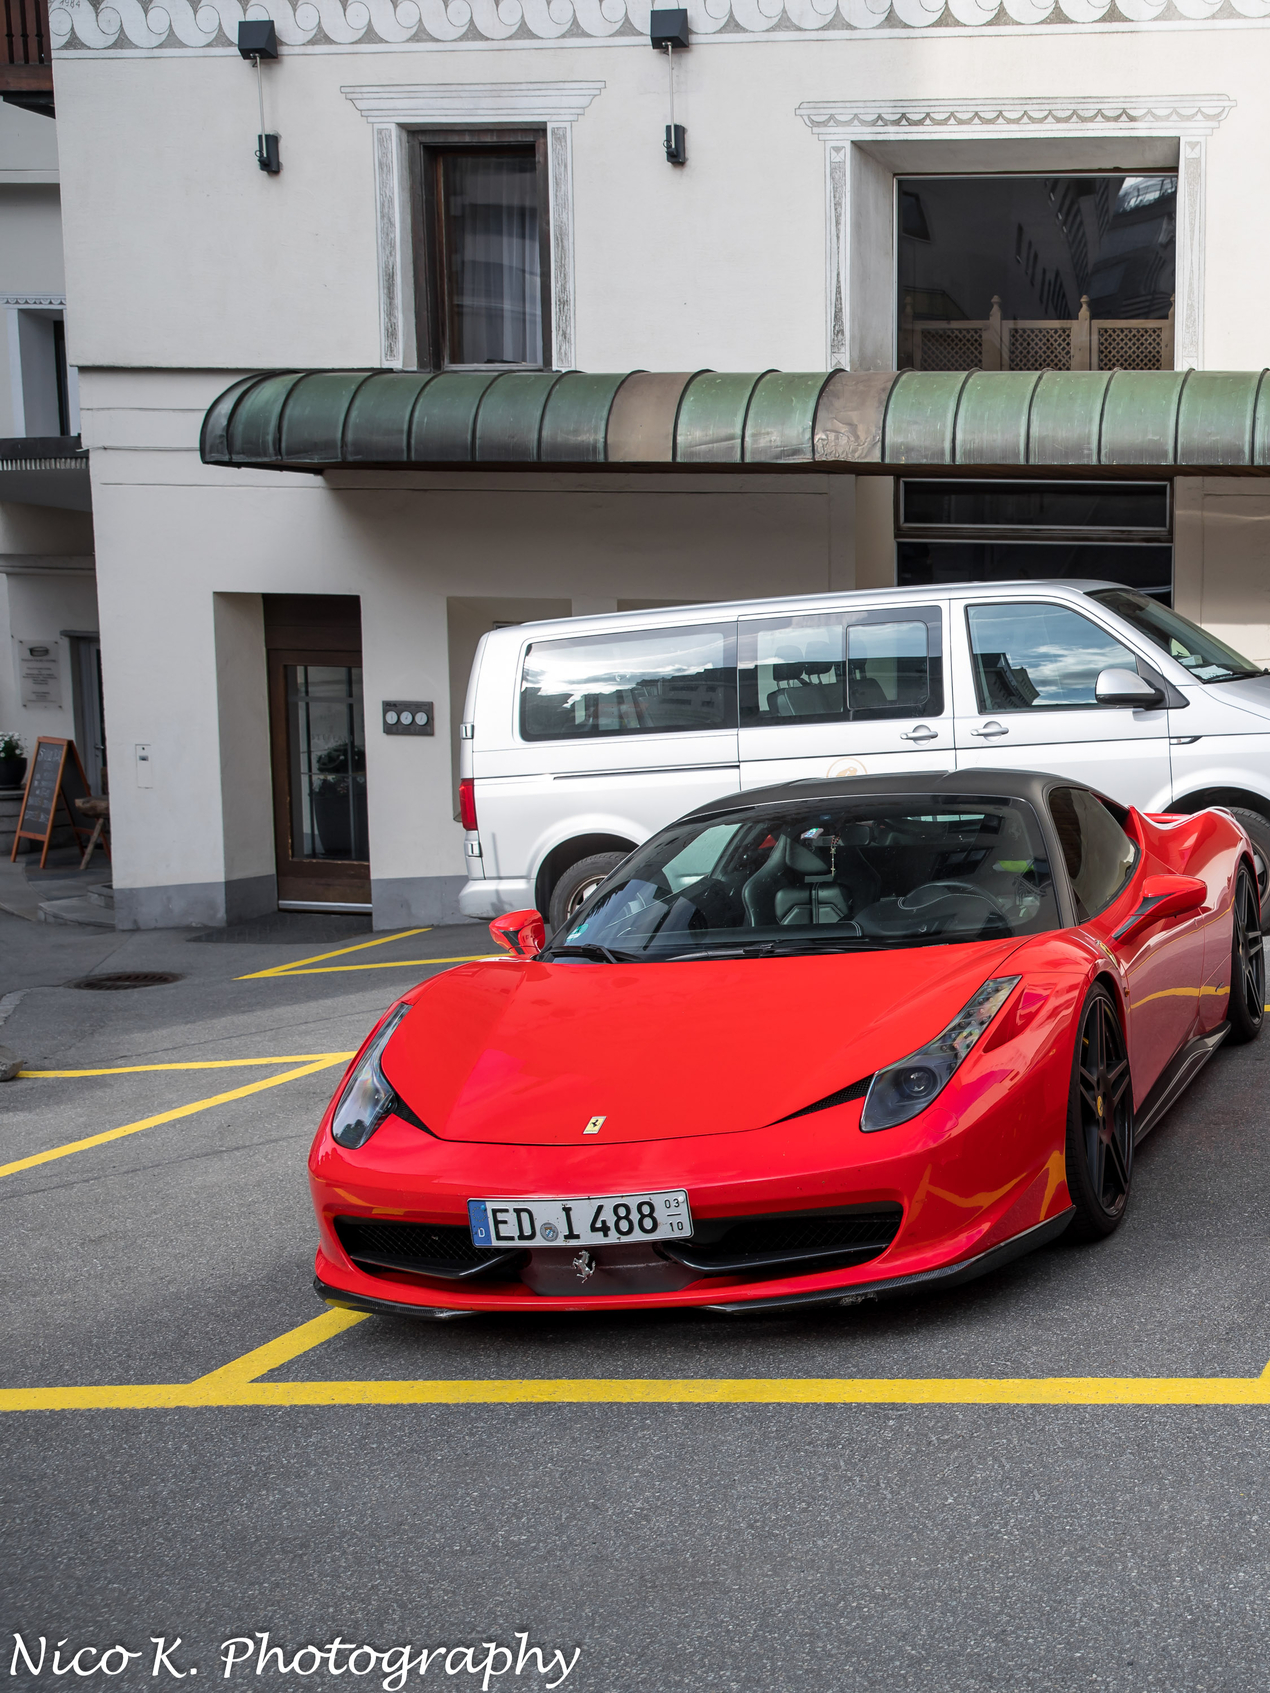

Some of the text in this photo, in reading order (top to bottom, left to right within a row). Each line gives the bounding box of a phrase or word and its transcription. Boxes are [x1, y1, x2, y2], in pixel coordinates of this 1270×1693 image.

[664, 1198, 682, 1209] 03
[477, 1200, 659, 1241] D ED I 488
[668, 1220, 684, 1232] 10
